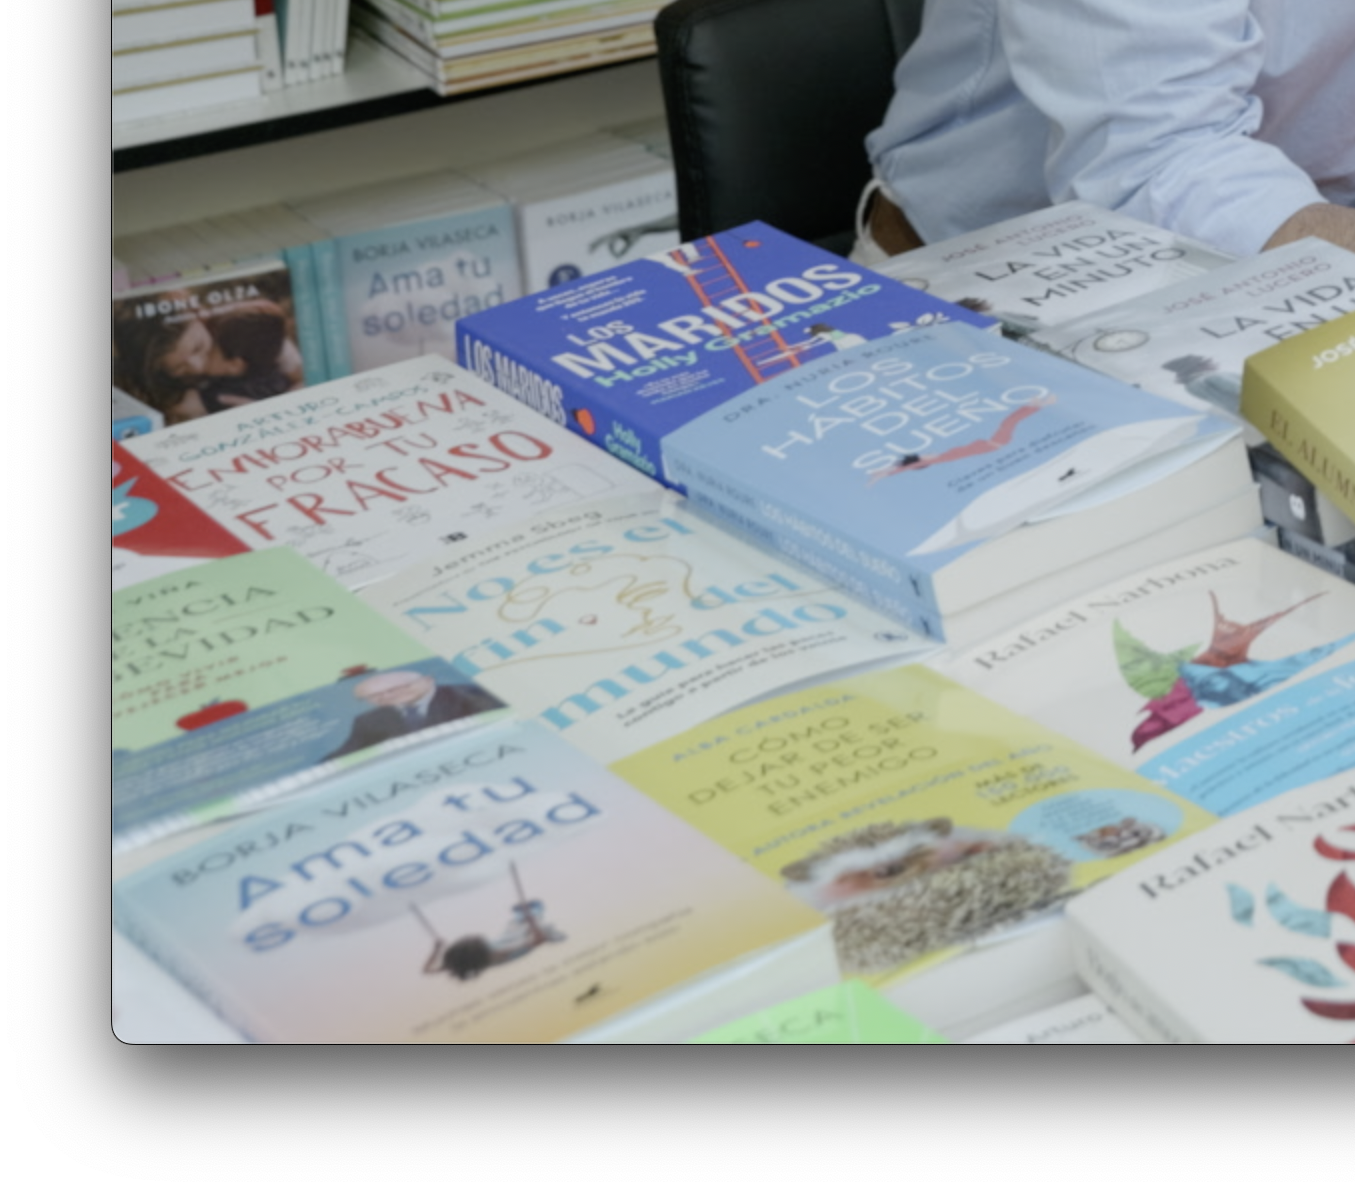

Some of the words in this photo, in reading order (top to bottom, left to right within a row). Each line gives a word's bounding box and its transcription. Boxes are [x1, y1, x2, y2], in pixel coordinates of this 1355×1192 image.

[351, 237, 410, 265] BORJA
[416, 221, 501, 254] VILASECA
[973, 256, 1031, 282] LA
[1044, 226, 1137, 261] VIDA
[1016, 219, 1097, 247] LUCERO
[1033, 254, 1097, 281] EN
[1102, 234, 1163, 262] UN
[135, 294, 200, 321] IBONE
[206, 284, 260, 307] OLZA
[366, 264, 447, 300] Ama
[454, 253, 494, 280] tu
[1021, 248, 1188, 308] MINUTO
[1162, 291, 1213, 315] JOSÉ
[1216, 255, 1319, 297] ANTONIO
[1245, 262, 1334, 299] LUCERO
[360, 284, 506, 339] soledad
[550, 263, 863, 380] MARIDOS
[566, 319, 637, 348] LOS
[592, 349, 700, 388] Holly
[704, 282, 882, 353] Gramazio
[1199, 314, 1260, 341] LA
[464, 334, 495, 384] LOS
[495, 354, 568, 429] MARIDOS
[760, 350, 1013, 461] HÁBITOS
[794, 357, 915, 410] LOS
[859, 387, 979, 437] DEL
[165, 388, 487, 493] ENHORABUENA
[235, 396, 341, 433] ARTURO
[851, 384, 1051, 475] SUEÑO
[1268, 409, 1294, 449] EL
[233, 428, 554, 543] FRACASO
[265, 455, 367, 493] POR
[364, 433, 440, 458] TU
[400, 575, 516, 633] No
[527, 538, 615, 577] es
[622, 516, 699, 545] el
[431, 524, 522, 578] Jemma
[529, 508, 604, 536] Sbeg
[144, 626, 199, 650] LA
[450, 615, 569, 679] fin
[689, 572, 805, 612] del
[972, 609, 1091, 674] Rafael
[1086, 553, 1242, 609] Narbona
[540, 599, 850, 732] mundo
[670, 734, 733, 764] ALBA
[735, 693, 857, 742] CARDALDA
[686, 748, 812, 808] DEJAR
[812, 730, 864, 758] DE
[866, 710, 931, 739] SER
[727, 714, 851, 767] CÓMO
[754, 770, 810, 799] TU
[809, 735, 909, 781] PEOR
[766, 744, 939, 819] ENEMIGO
[973, 770, 1019, 792] MÁS
[171, 818, 316, 889] BORJA
[319, 742, 529, 821] VILASECA
[236, 817, 427, 913] Ama
[441, 773, 541, 814] tu
[750, 816, 835, 858] AUTORA
[837, 767, 967, 827] REVELACIÓN
[242, 790, 606, 956] soledad
[1137, 820, 1276, 903] Rafael
